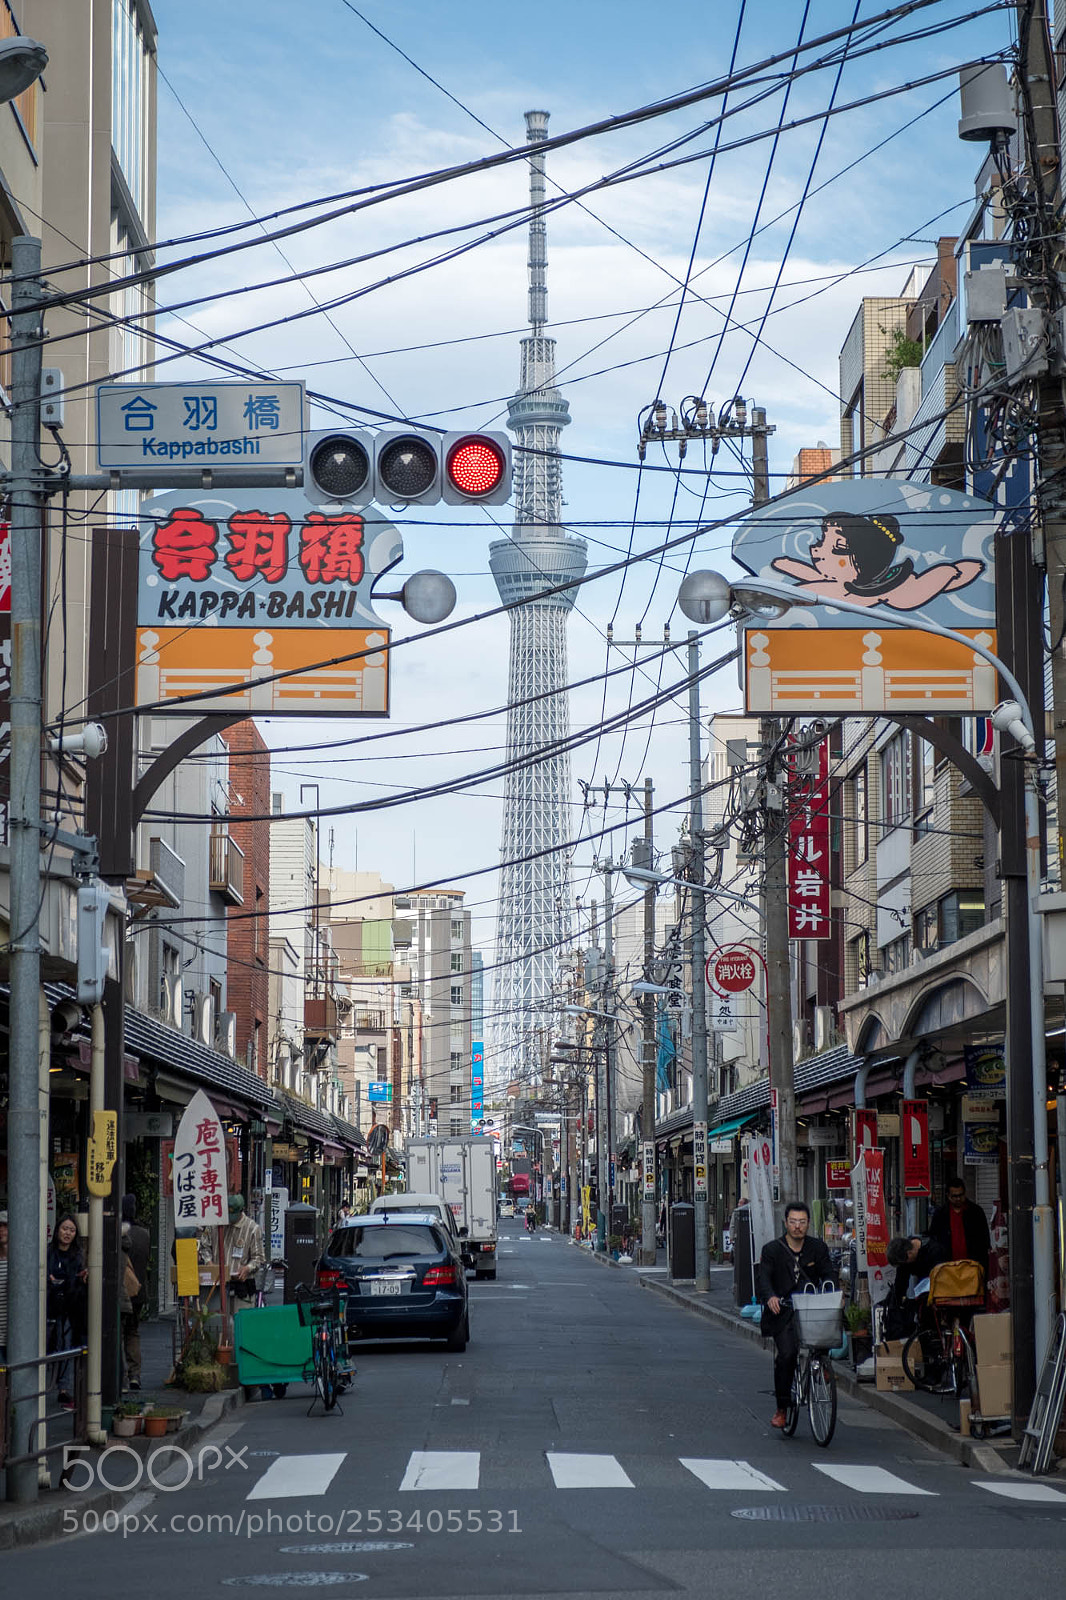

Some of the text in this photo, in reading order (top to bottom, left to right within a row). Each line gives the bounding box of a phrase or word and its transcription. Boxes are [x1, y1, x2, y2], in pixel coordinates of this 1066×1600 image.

[121, 394, 281, 432] 合羽橋
[142, 436, 261, 459] Kappabashi
[152, 507, 366, 586] 合羽橋
[718, 963, 753, 981] 消火栓
[176, 1152, 197, 1217] つば屋
[195, 1118, 222, 1218] 庖丁専門
[866, 1168, 880, 1183] TAX
